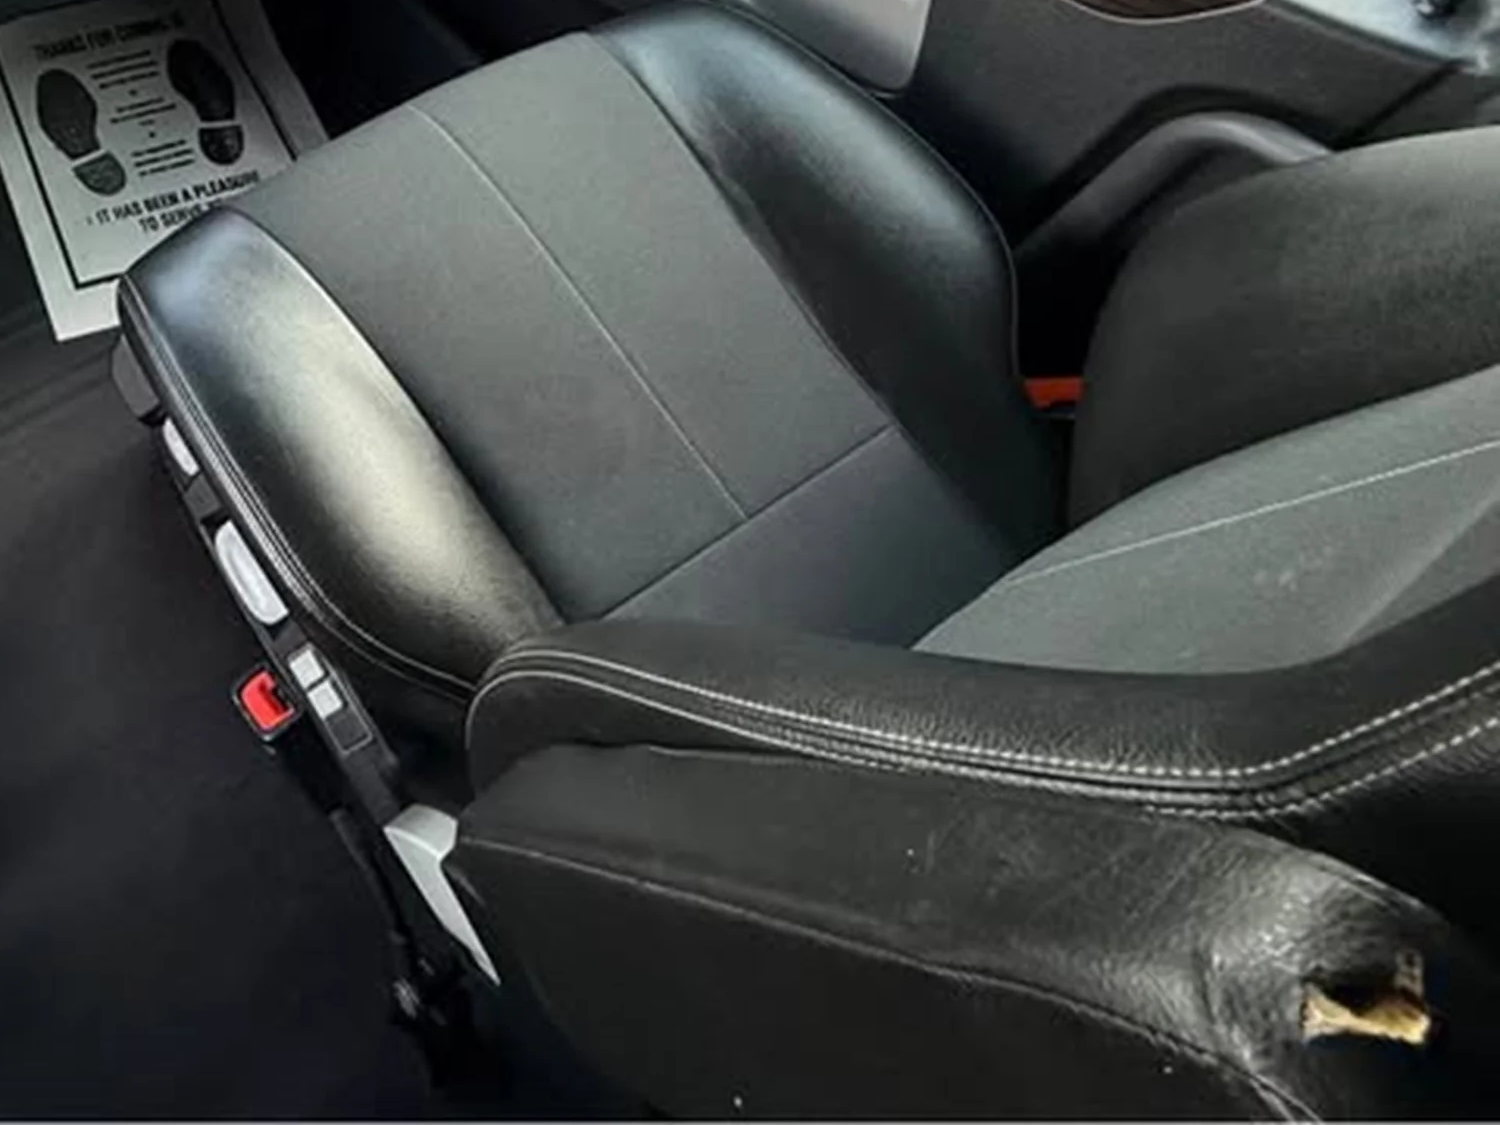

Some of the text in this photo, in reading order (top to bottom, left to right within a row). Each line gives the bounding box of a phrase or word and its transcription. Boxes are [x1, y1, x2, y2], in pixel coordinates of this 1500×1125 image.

[112, 200, 143, 221] HAS
[143, 191, 180, 215] BEEN
[181, 187, 193, 202] A
[138, 215, 161, 233] TO
